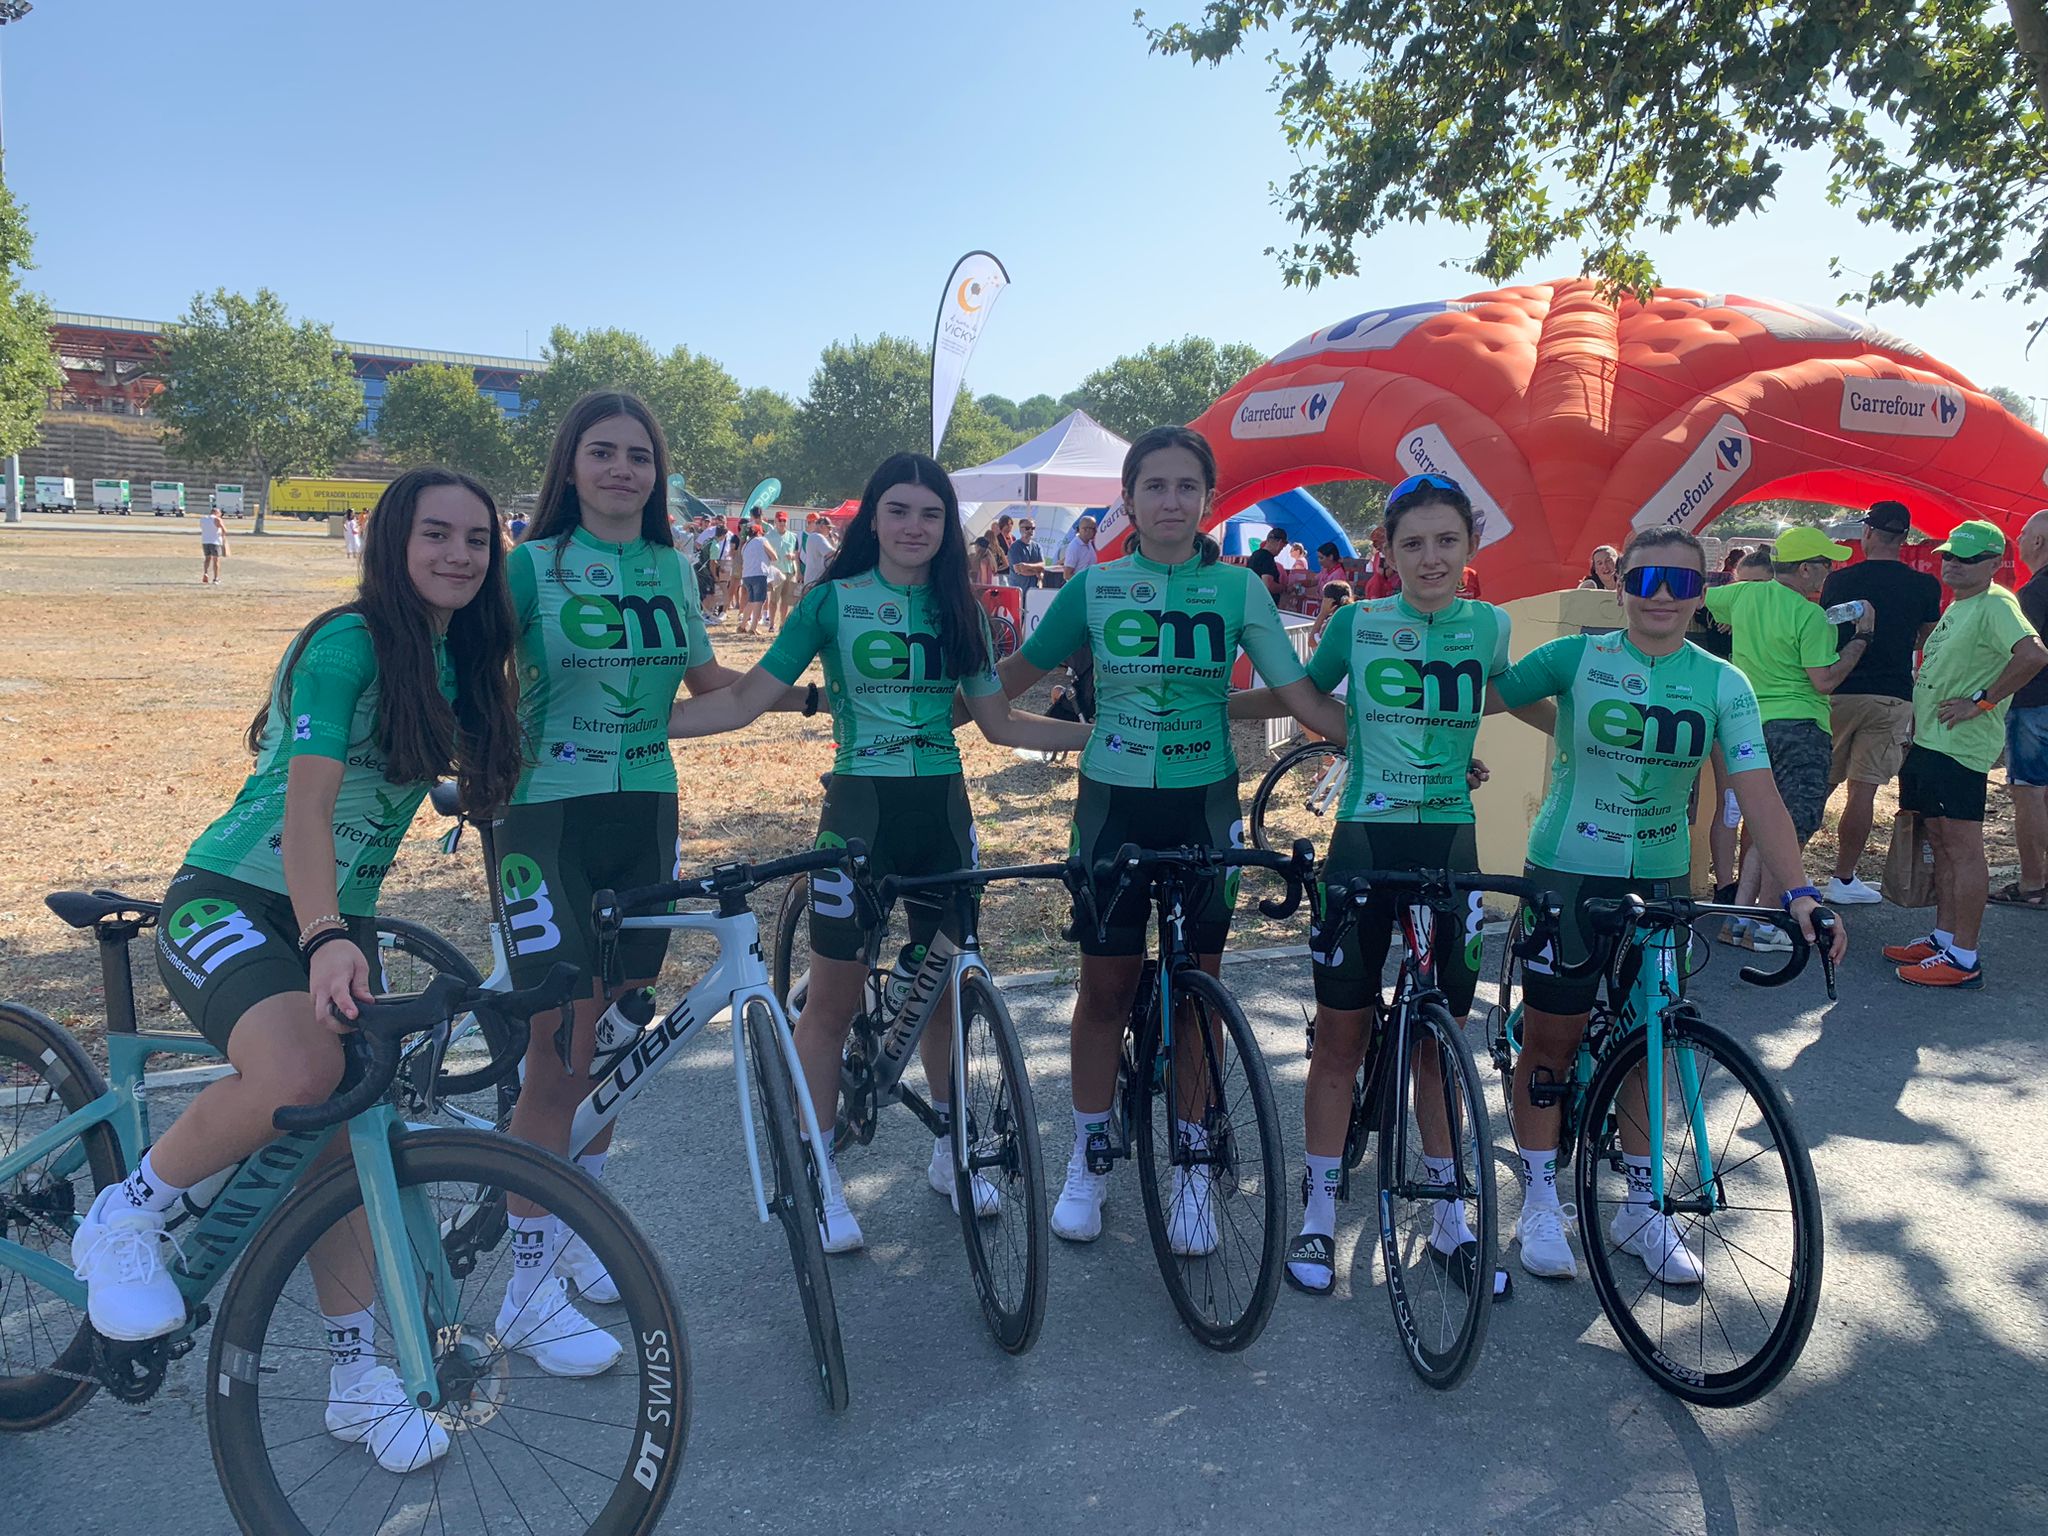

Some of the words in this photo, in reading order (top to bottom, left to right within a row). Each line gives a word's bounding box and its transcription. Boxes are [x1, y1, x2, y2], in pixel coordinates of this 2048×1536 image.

[1240, 402, 1297, 424] Carrefour
[1850, 391, 1926, 417] Carrefour
[313, 490, 346, 499] OPERADOR
[1662, 472, 1714, 526] rrefour
[560, 594, 687, 649] em
[1103, 609, 1226, 663] em
[561, 652, 687, 669] electromercanti
[1102, 661, 1225, 679] electromercantil
[1364, 658, 1483, 714] em
[572, 716, 659, 734] Extremadura
[1118, 713, 1202, 732] Extremadura
[1365, 709, 1479, 729] electromercanti
[1587, 698, 1706, 757] em
[625, 742, 665, 761] GR-100
[1162, 741, 1211, 756] GR-100
[1382, 769, 1453, 785] Extremadura
[1594, 798, 1672, 818] Extremadura
[1636, 823, 1678, 841] GR-100
[500, 852, 561, 956] em
[168, 898, 267, 974] em
[591, 1000, 695, 1116] CUBE
[642, 1328, 674, 1428] SWISS
[632, 1431, 666, 1492] DT
